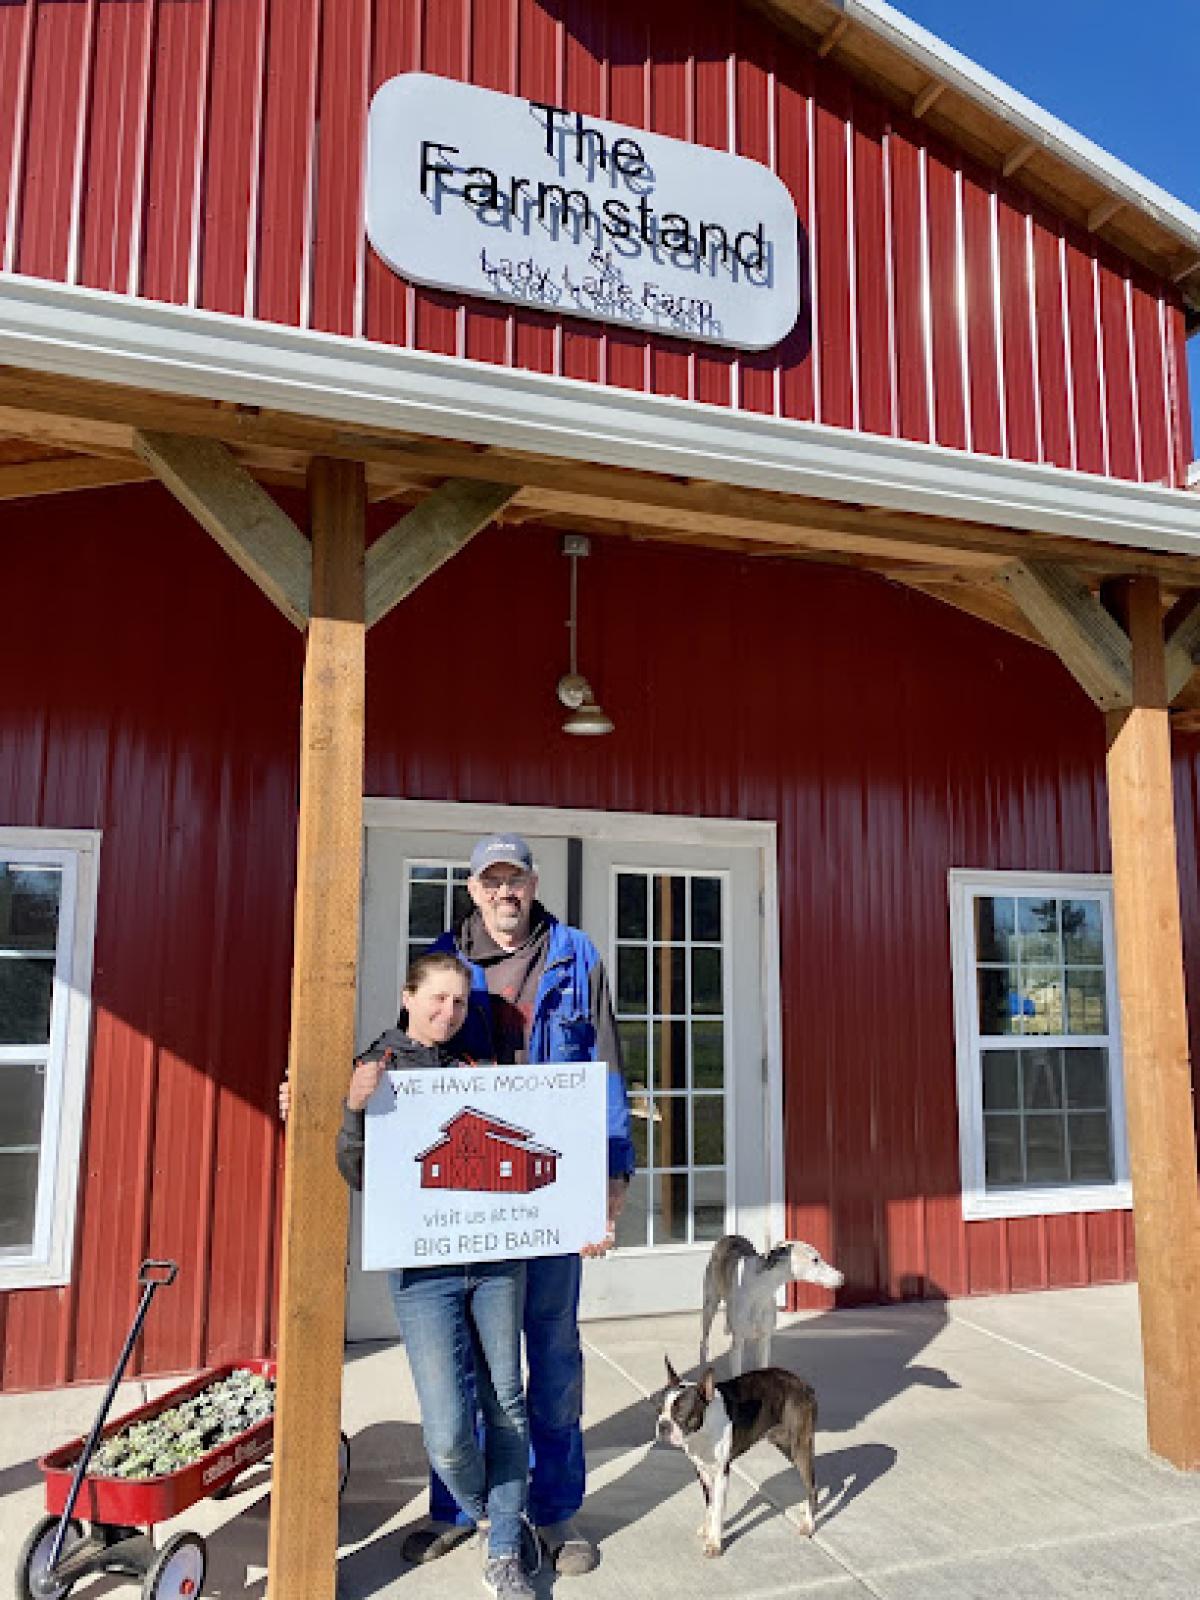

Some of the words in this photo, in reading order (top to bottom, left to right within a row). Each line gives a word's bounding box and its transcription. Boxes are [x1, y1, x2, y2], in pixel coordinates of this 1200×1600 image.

[529, 102, 645, 169] The
[420, 140, 765, 272] Farmstand
[480, 247, 551, 290] Lady
[643, 282, 712, 322] Farm
[432, 1075, 486, 1094] HAVE
[423, 1209, 461, 1228] visit
[465, 1210, 486, 1225] us
[491, 1207, 507, 1224] at
[512, 1205, 540, 1222] the
[414, 1237, 451, 1257] BIG
[458, 1232, 499, 1254] RED
[505, 1228, 560, 1251] BARN
